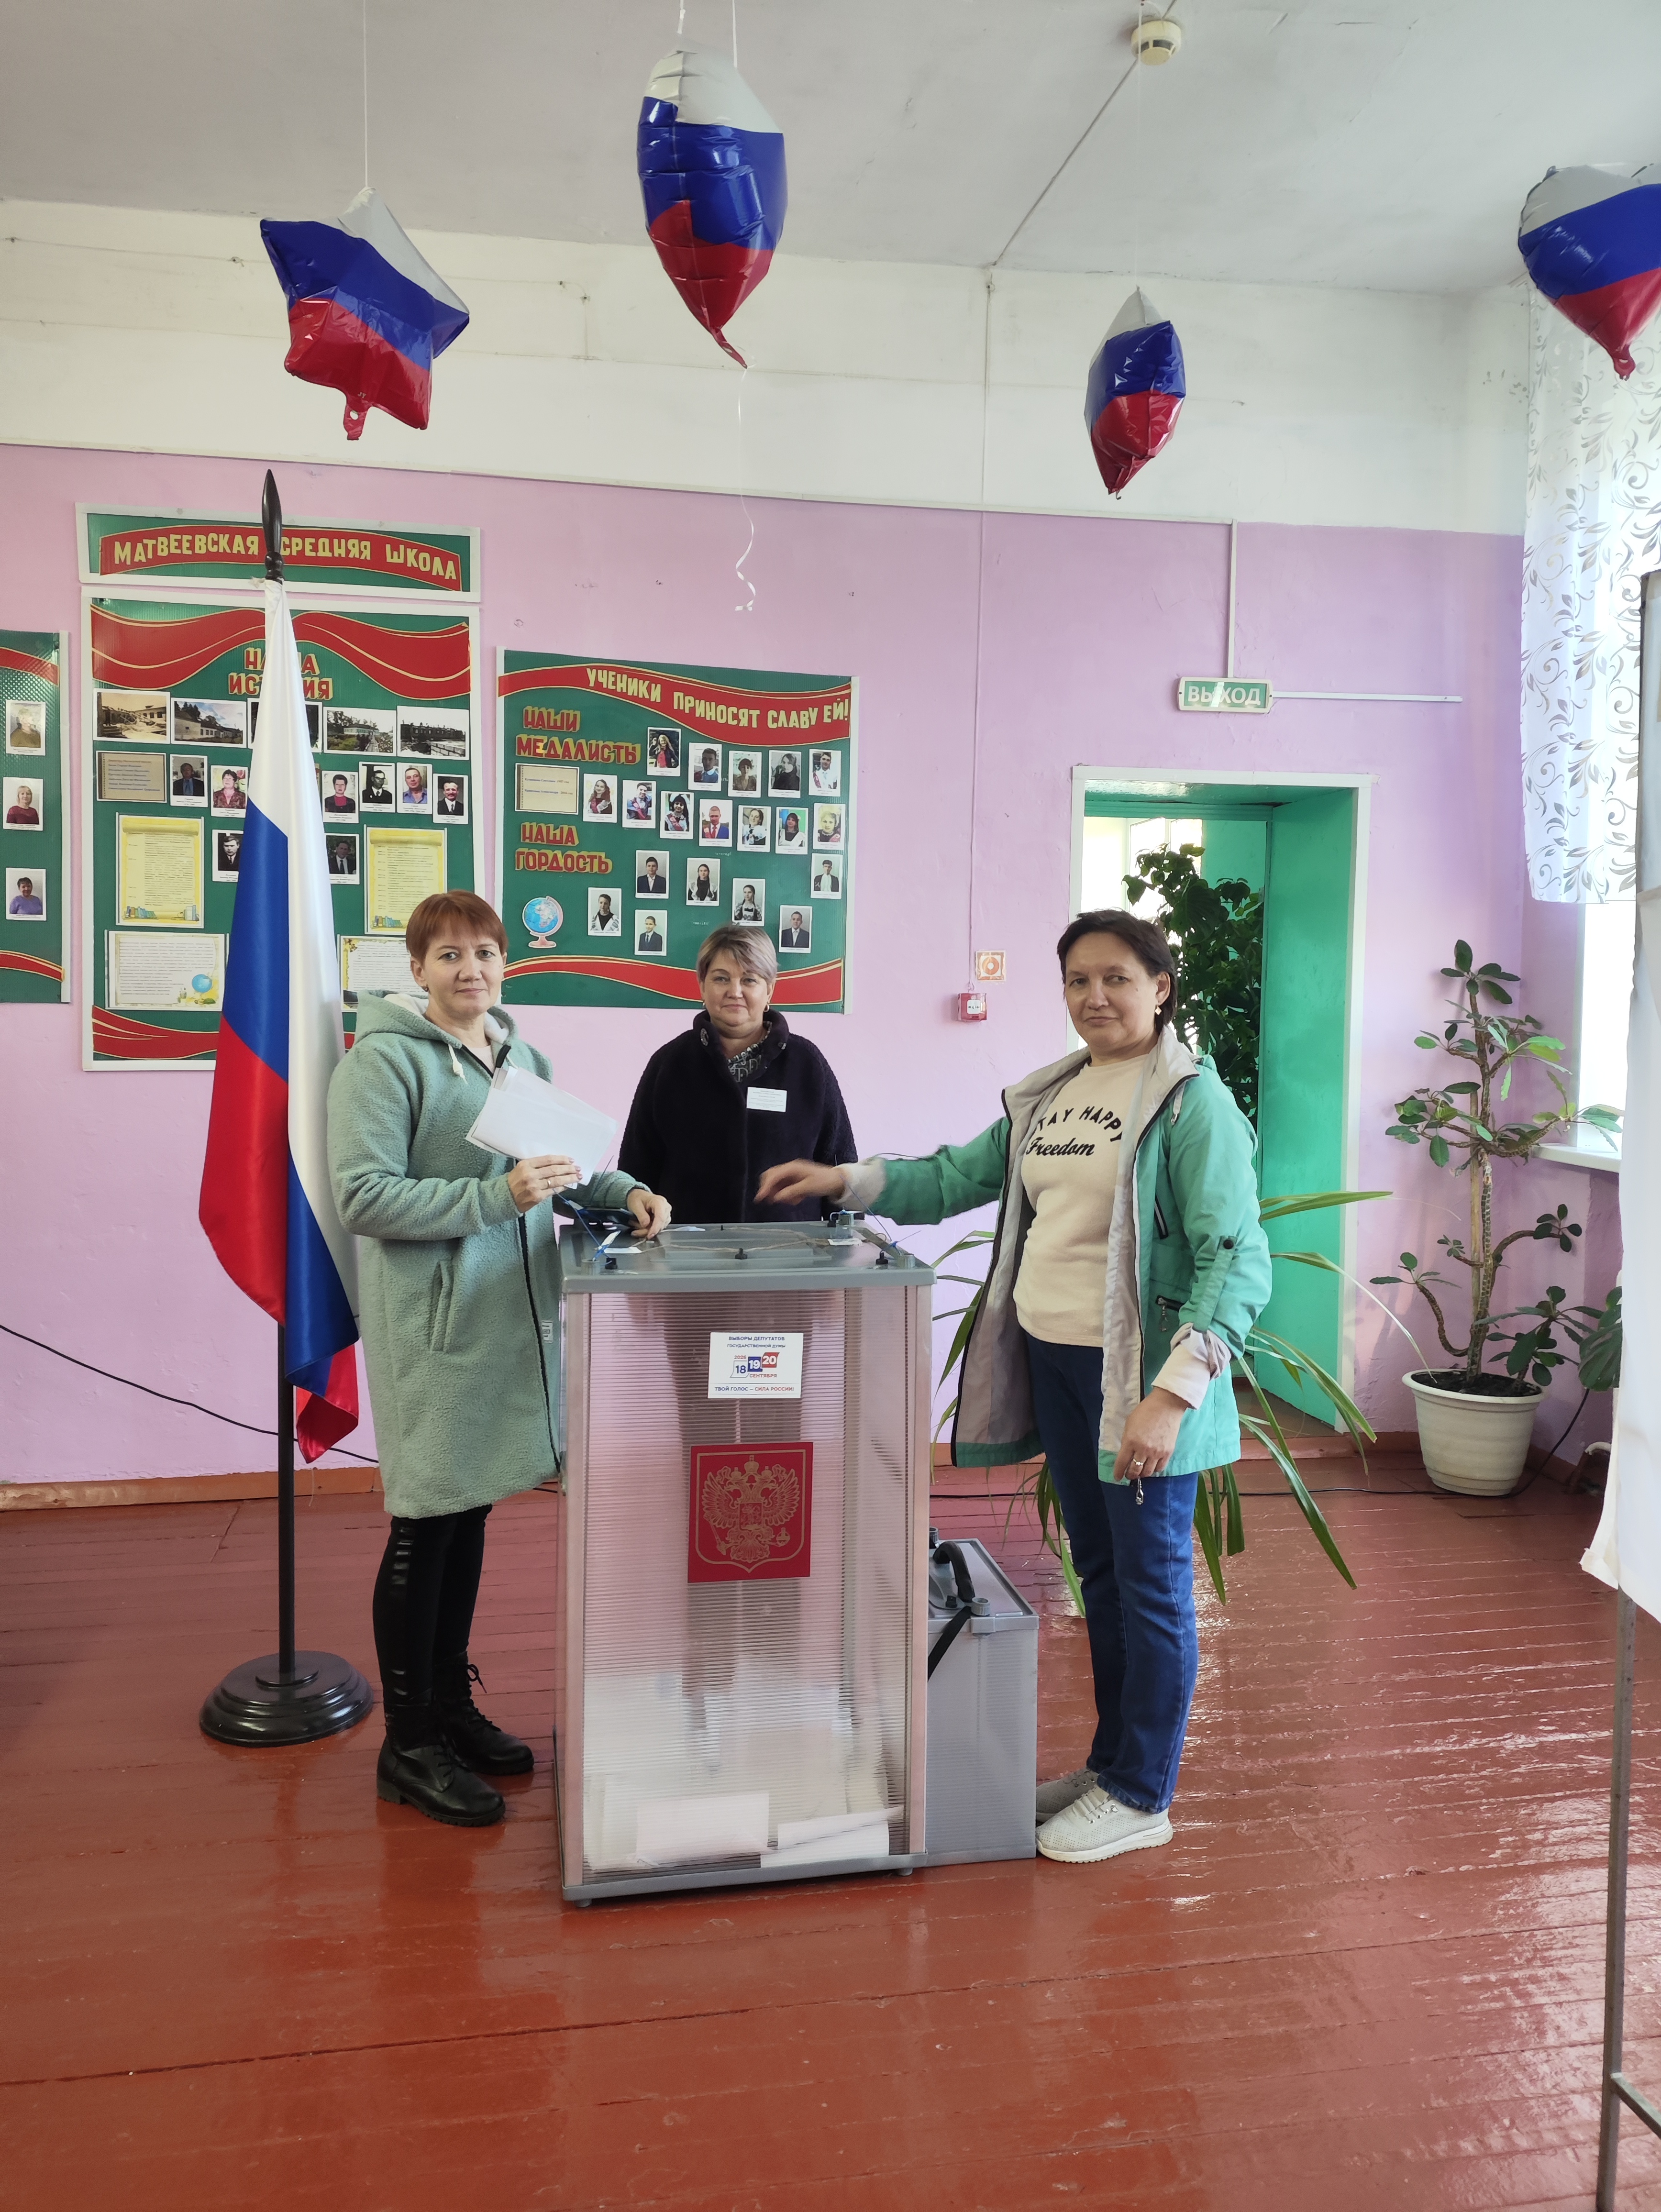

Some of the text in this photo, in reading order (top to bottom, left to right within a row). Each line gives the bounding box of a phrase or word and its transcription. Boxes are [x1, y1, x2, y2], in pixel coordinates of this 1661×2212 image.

[114, 532, 457, 580] МАТВЕЕВСКАЯ СРЕДНЯЯ ШКОЛА
[244, 647, 320, 675] НА
[228, 672, 333, 700] ИСИЯ
[586, 668, 849, 729] УЧЕНИКИ ПРИНОСЯТ СЛАВУ ЕЙ!
[1187, 686, 1261, 706] ВЫХОД
[523, 706, 580, 732] НАШИ
[520, 821, 579, 846] НАША
[515, 848, 612, 874] ГОРДОСТЬ
[1037, 1108, 1074, 1132] TAY
[1026, 1136, 1096, 1156] Freedom
[735, 1365, 746, 1373] 18
[748, 1360, 760, 1369] 19
[762, 1355, 776, 1364] 20
